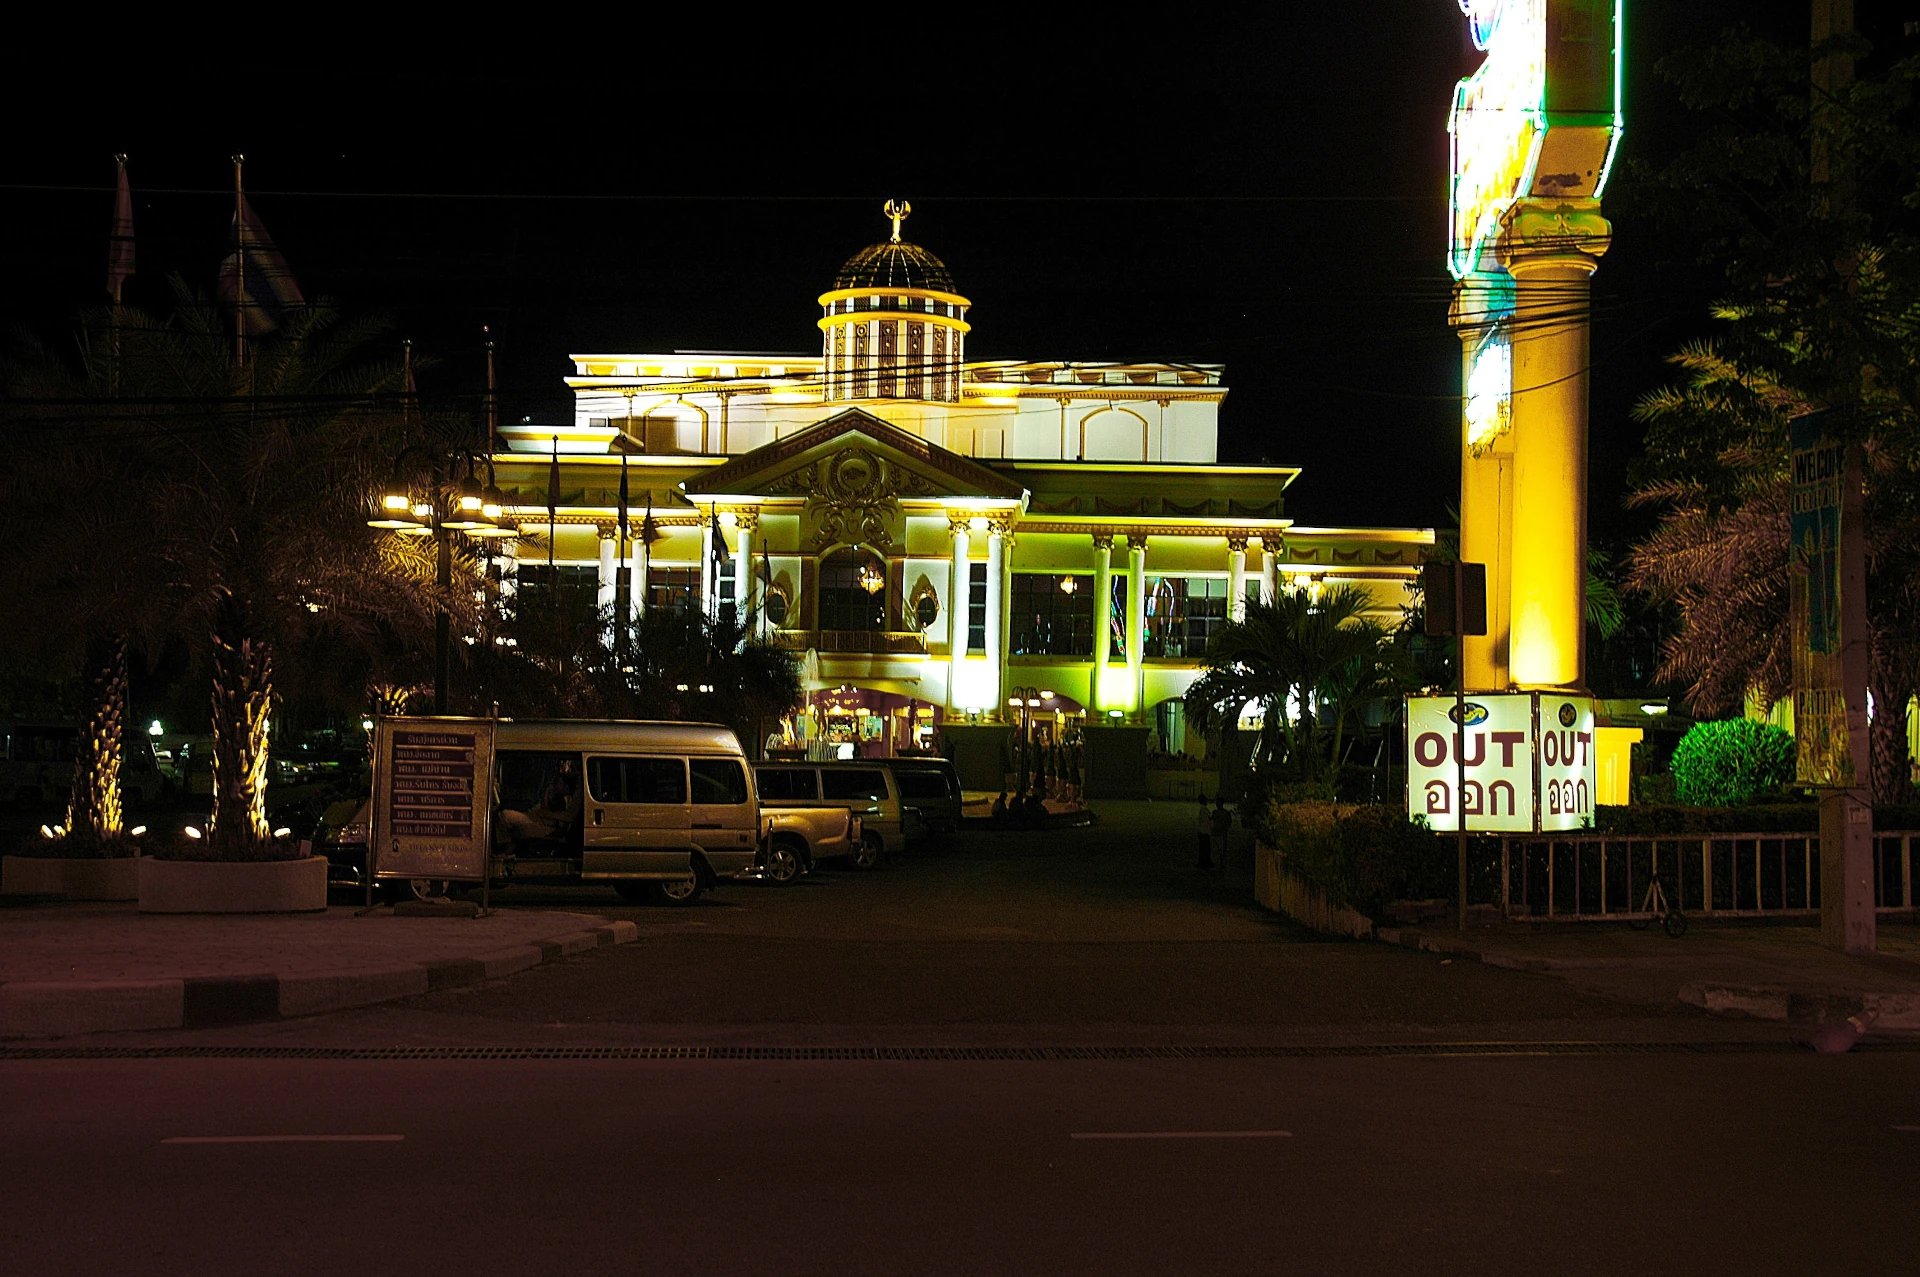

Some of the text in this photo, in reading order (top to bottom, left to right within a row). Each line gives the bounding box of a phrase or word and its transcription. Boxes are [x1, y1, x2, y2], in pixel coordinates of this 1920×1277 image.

[1414, 731, 1525, 768] OUT
[1543, 730, 1591, 767] OUT
[1424, 779, 1515, 816] ออก
[1548, 778, 1588, 815] ออก
